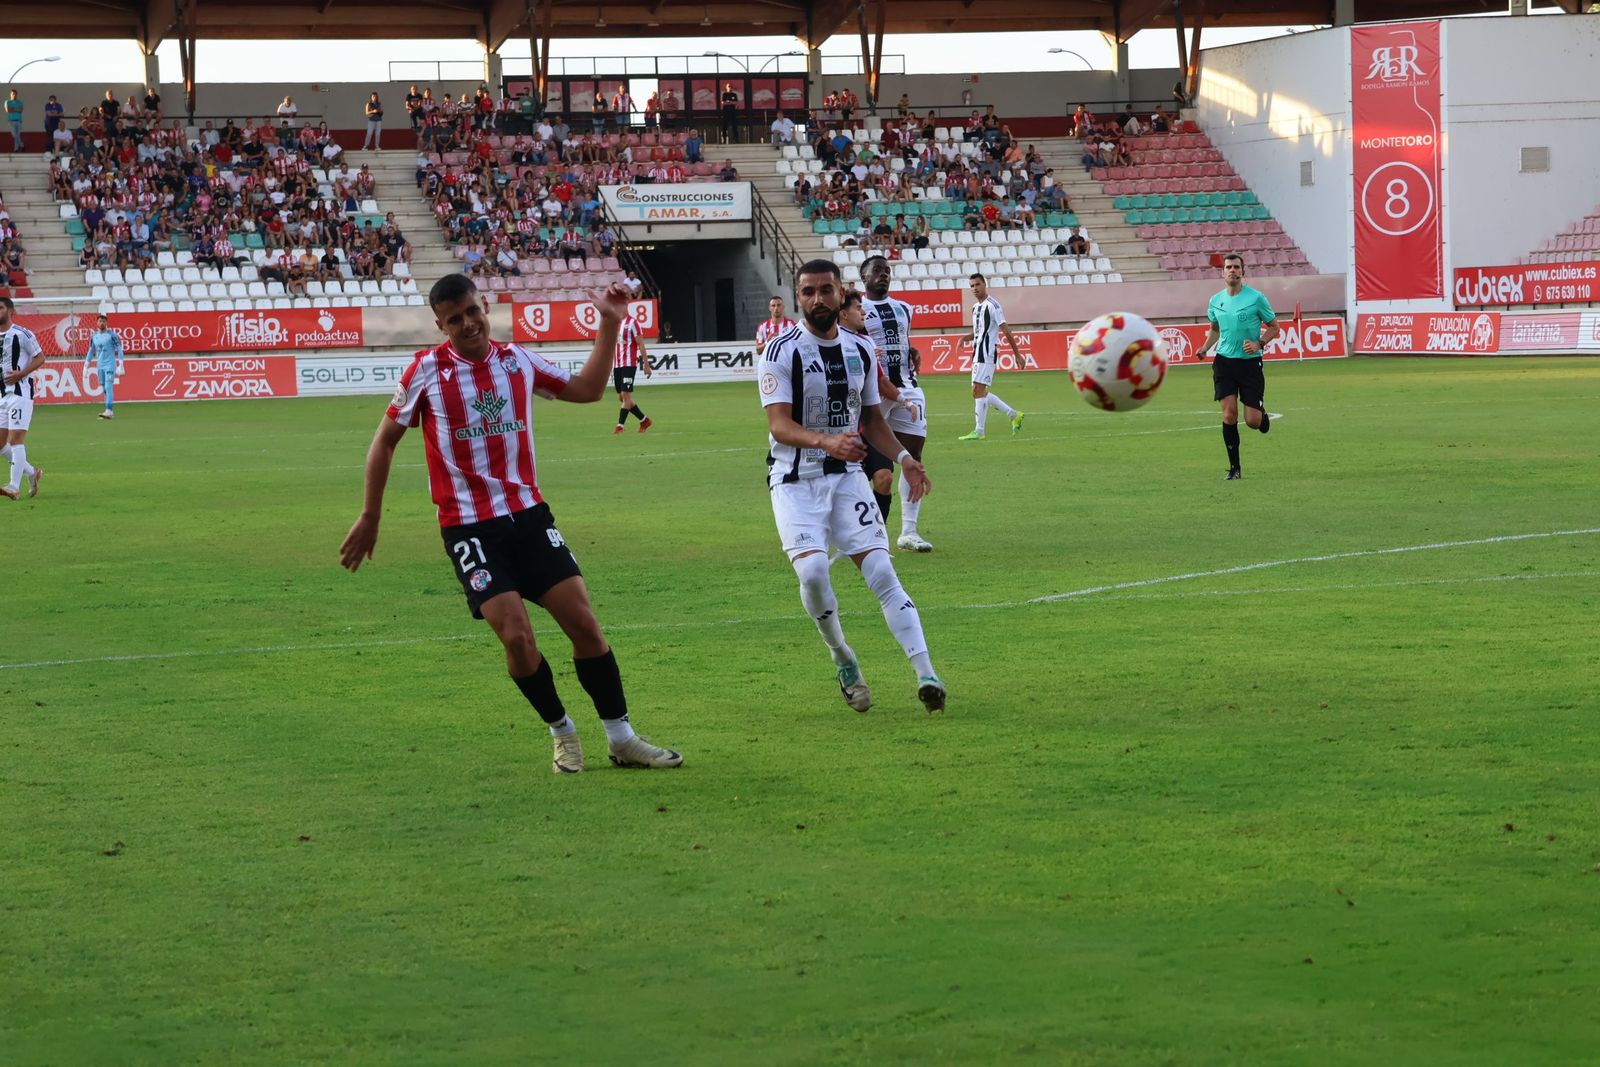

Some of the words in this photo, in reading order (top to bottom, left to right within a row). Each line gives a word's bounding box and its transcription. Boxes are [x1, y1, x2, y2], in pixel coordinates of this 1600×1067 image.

[1360, 134, 1433, 149] MONTETORO
[1385, 178, 1410, 218] 8
[712, 210, 733, 218] S.A.
[1455, 269, 1524, 304] cubiex
[1525, 265, 1597, 282] www.cubiex.es
[1546, 286, 1561, 300] 675
[1561, 285, 1575, 299] 630
[1577, 284, 1591, 299] 110
[533, 307, 545, 327] 8
[583, 306, 596, 325] 8
[636, 304, 648, 323] 8
[139, 322, 202, 339] ÓPTICO
[230, 312, 281, 336] fisio
[1429, 315, 1471, 332] FUNDACIÓN
[295, 329, 360, 347] podoactiva
[1304, 324, 1339, 353] CF
[1374, 334, 1413, 350] ZAMORA
[697, 350, 754, 369] PRM
[301, 368, 365, 383] SOLID
[182, 378, 274, 398] ZAMORA
[11, 408, 22, 420] 21
[456, 427, 486, 440] CAJA
[488, 420, 526, 435] RURAL
[453, 537, 488, 573] 21
